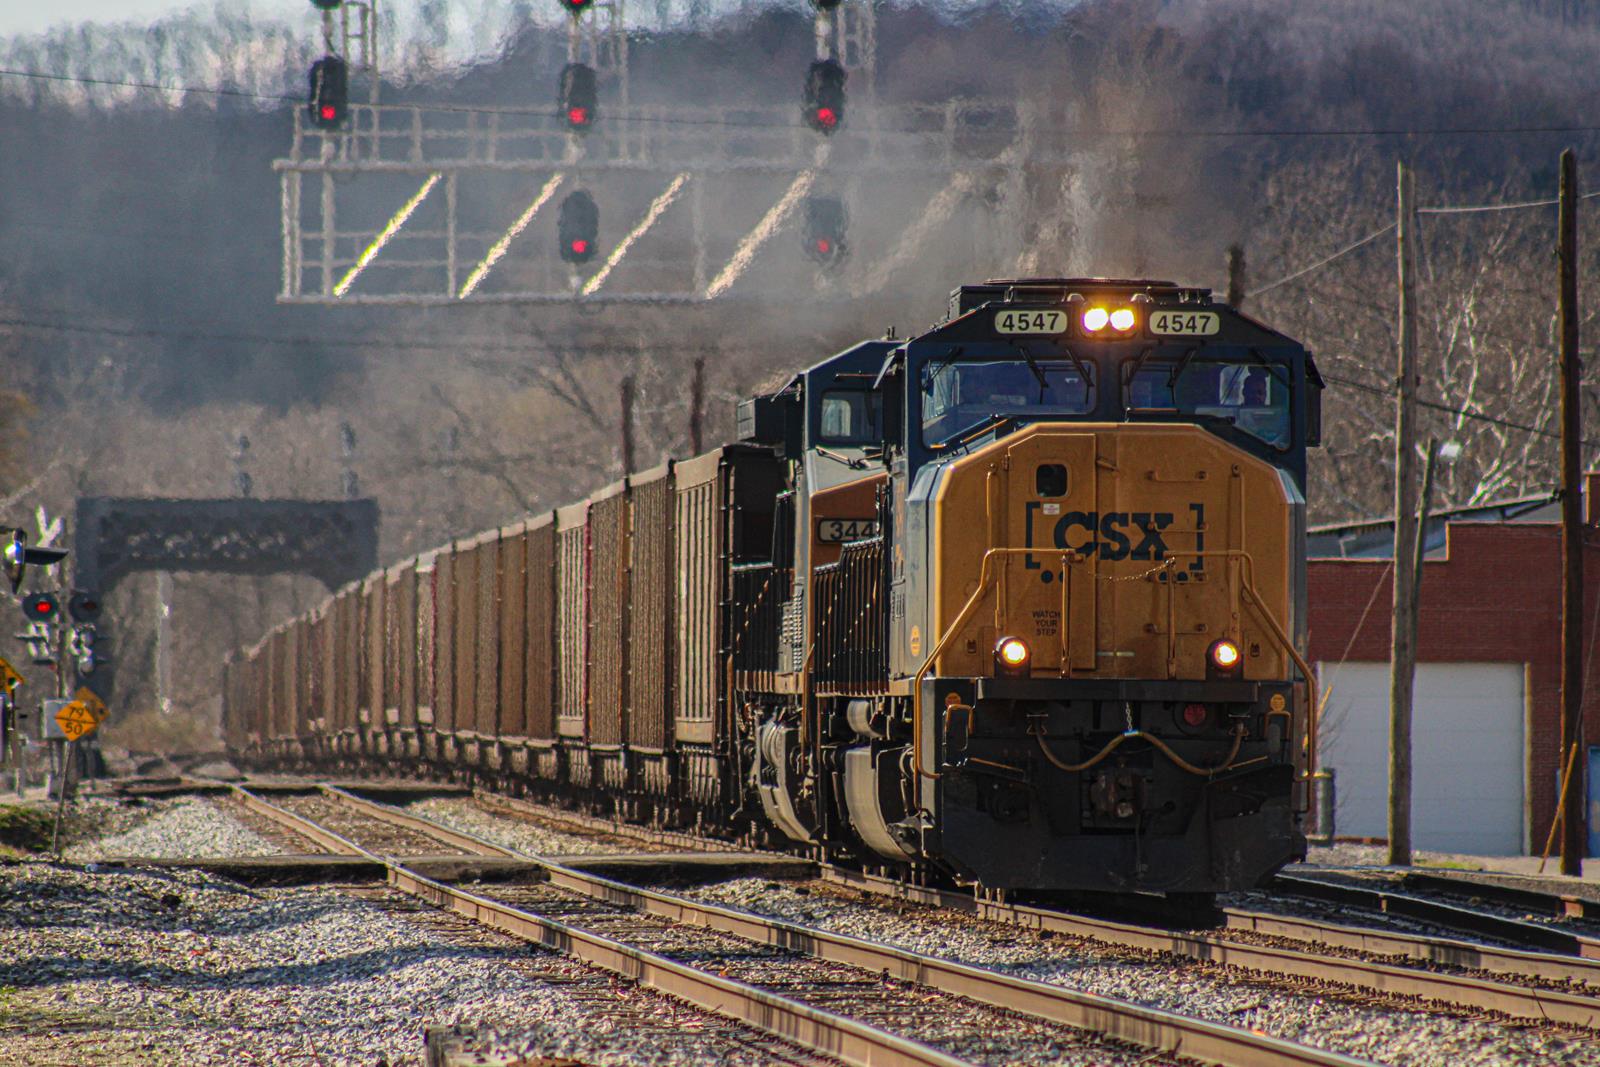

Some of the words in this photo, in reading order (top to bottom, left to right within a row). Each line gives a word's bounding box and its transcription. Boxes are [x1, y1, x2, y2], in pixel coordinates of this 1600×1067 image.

[1002, 312, 1060, 332] 4547
[1156, 314, 1211, 333] 4547
[830, 520, 876, 541] 344
[1053, 511, 1174, 561] CSX
[1032, 610, 1061, 619] WATCH
[1035, 619, 1057, 627] YOUR
[1036, 628, 1056, 636] STEP
[65, 722, 83, 735] 50
